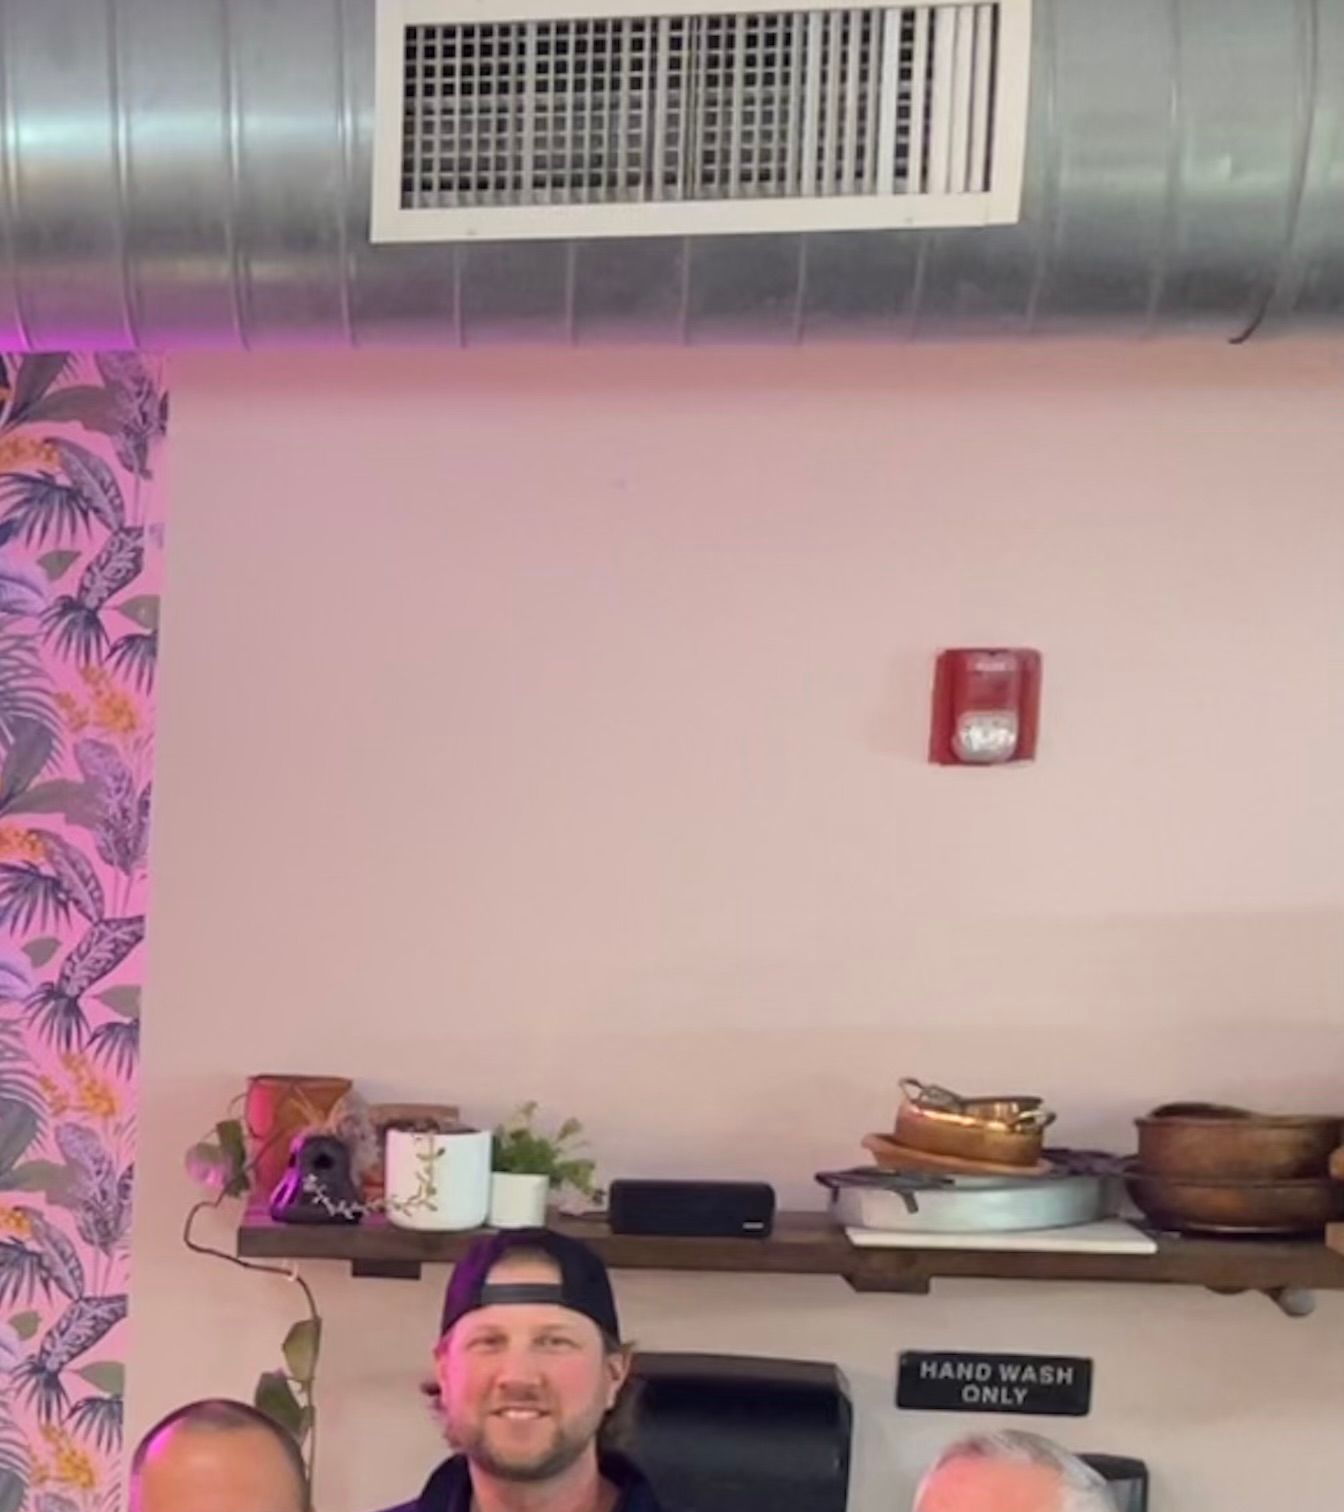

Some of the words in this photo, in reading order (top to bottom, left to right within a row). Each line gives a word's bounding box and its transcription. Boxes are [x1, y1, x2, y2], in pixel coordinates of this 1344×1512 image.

[919, 1361, 991, 1382] HAND
[998, 1364, 1073, 1386] WASH
[961, 1384, 1029, 1405] ONLY
